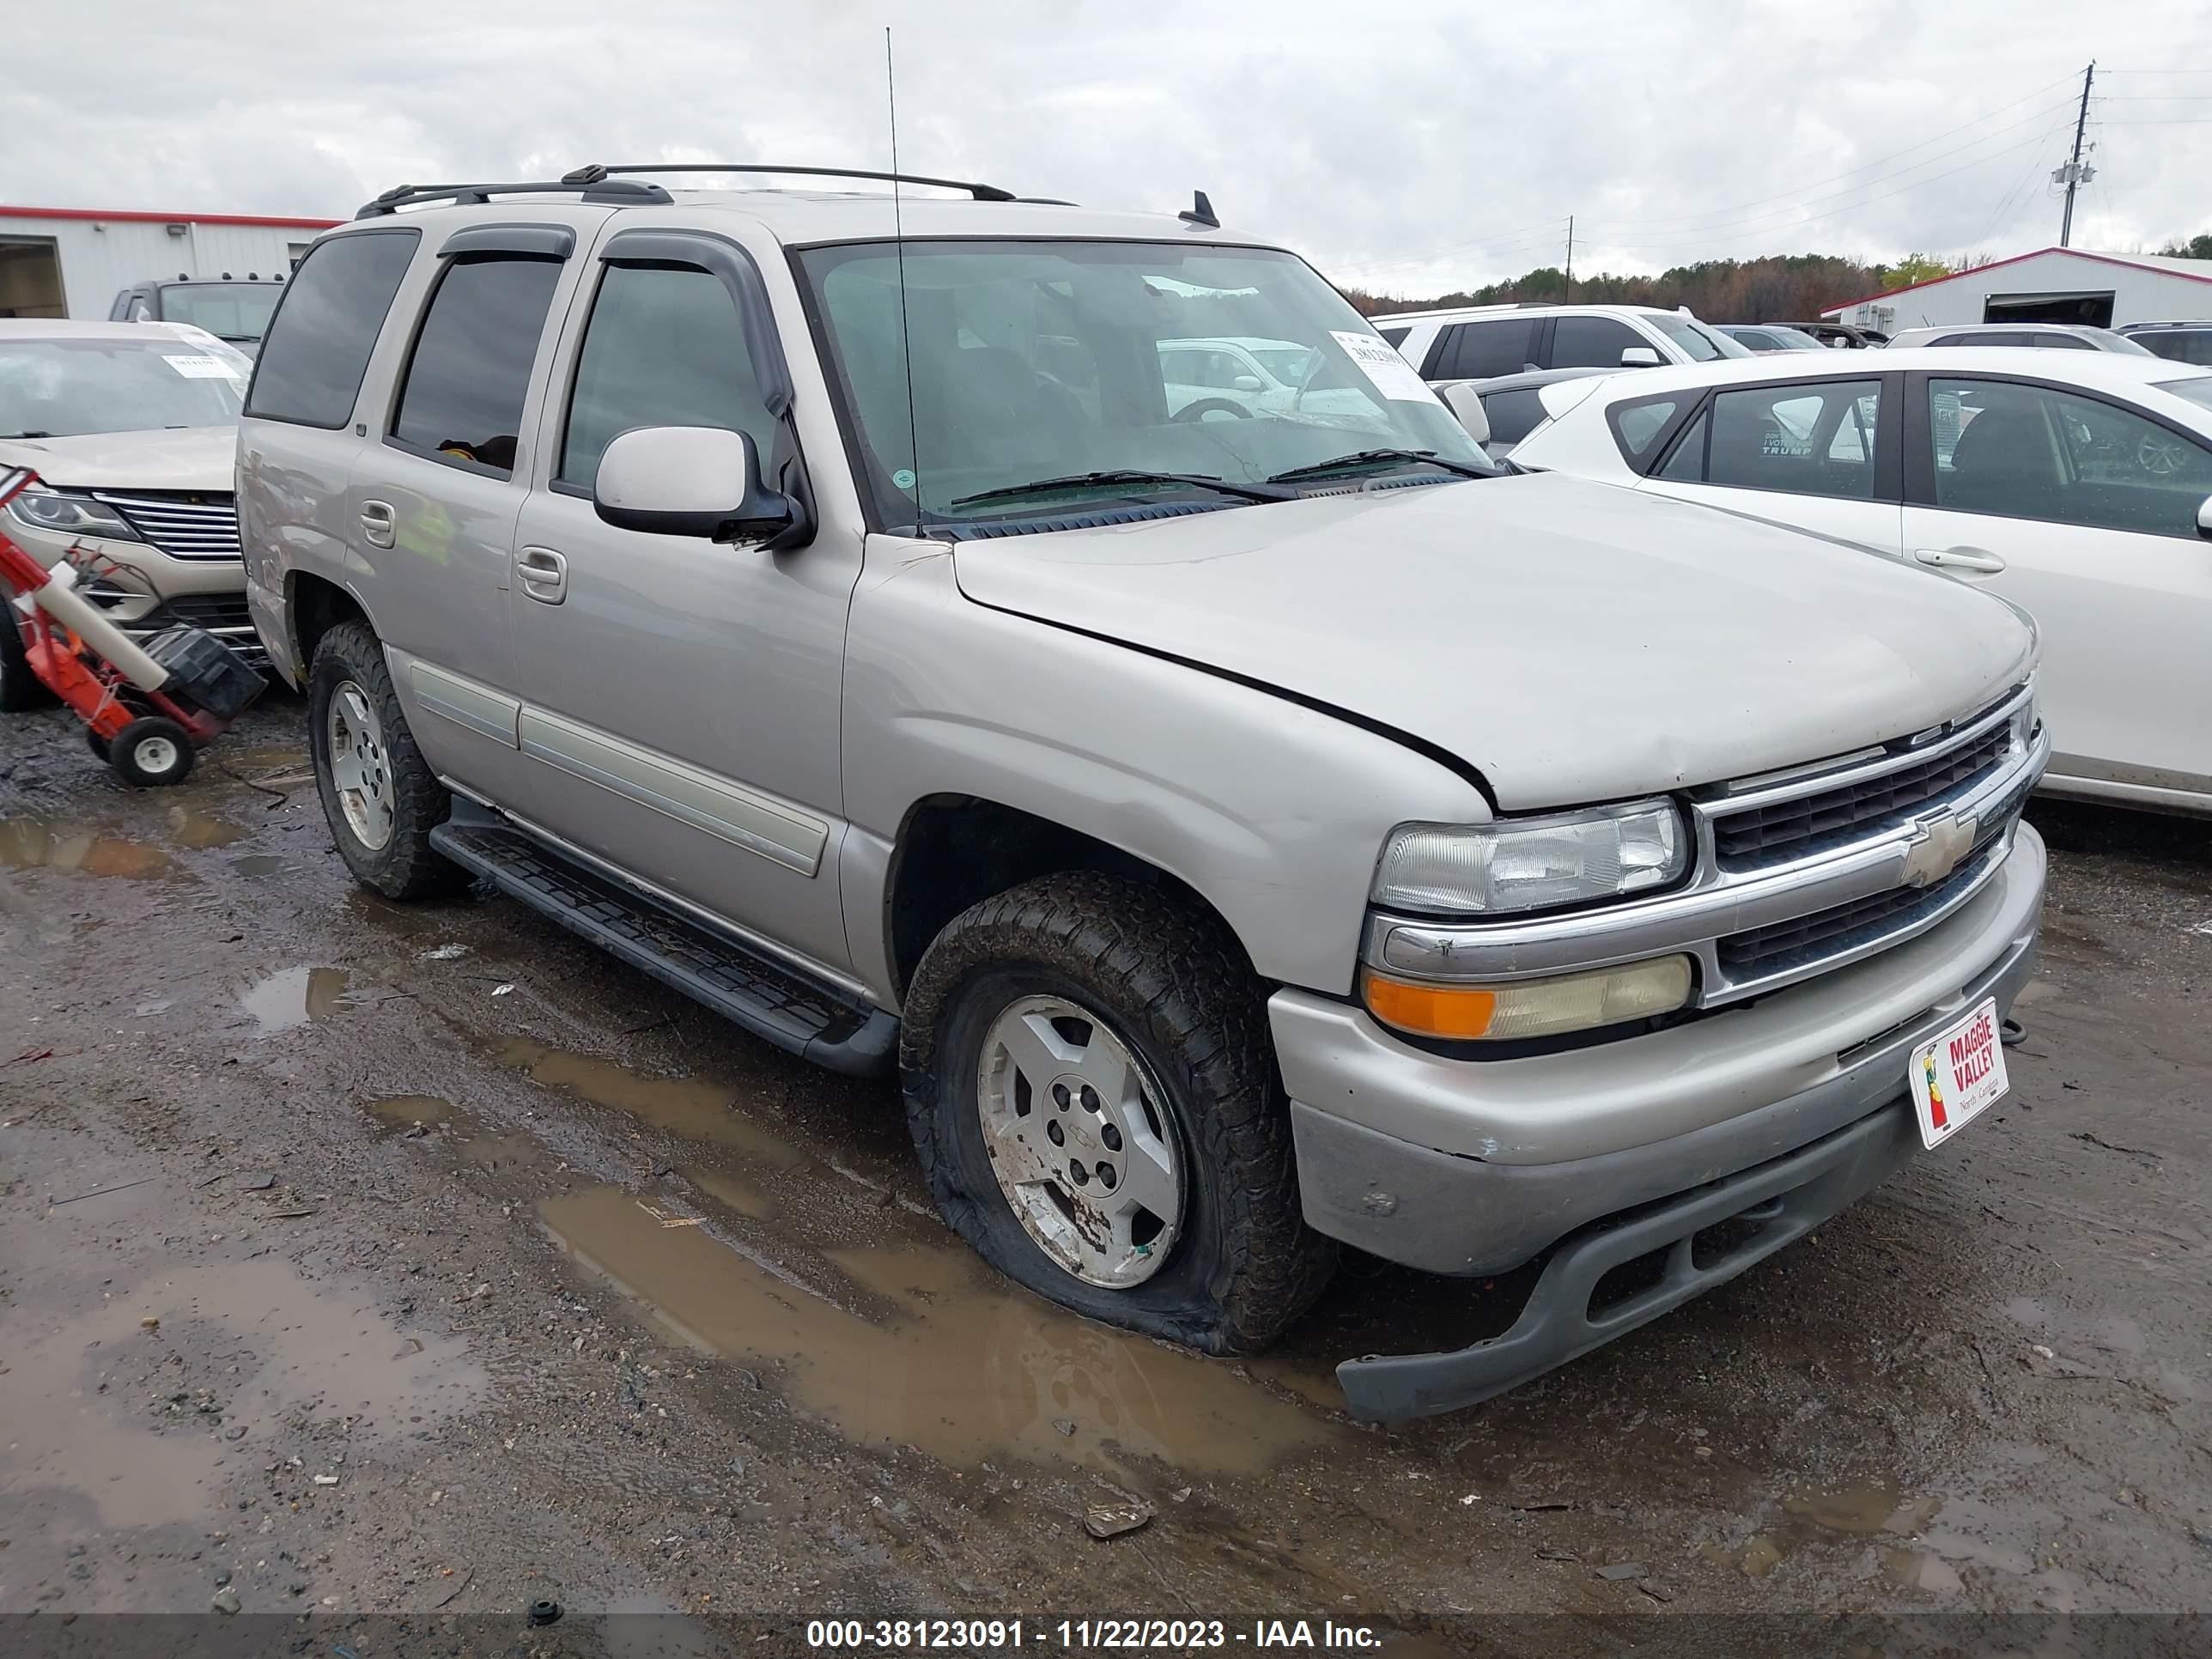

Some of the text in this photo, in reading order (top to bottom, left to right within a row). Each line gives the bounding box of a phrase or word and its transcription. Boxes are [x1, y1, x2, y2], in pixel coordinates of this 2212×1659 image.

[1762, 447, 1812, 455] TRUMP
[1950, 1015, 1993, 1066] MAGGIE
[1954, 1042, 1994, 1092] VALLEY
[1960, 1078, 1999, 1114] North Carolina
